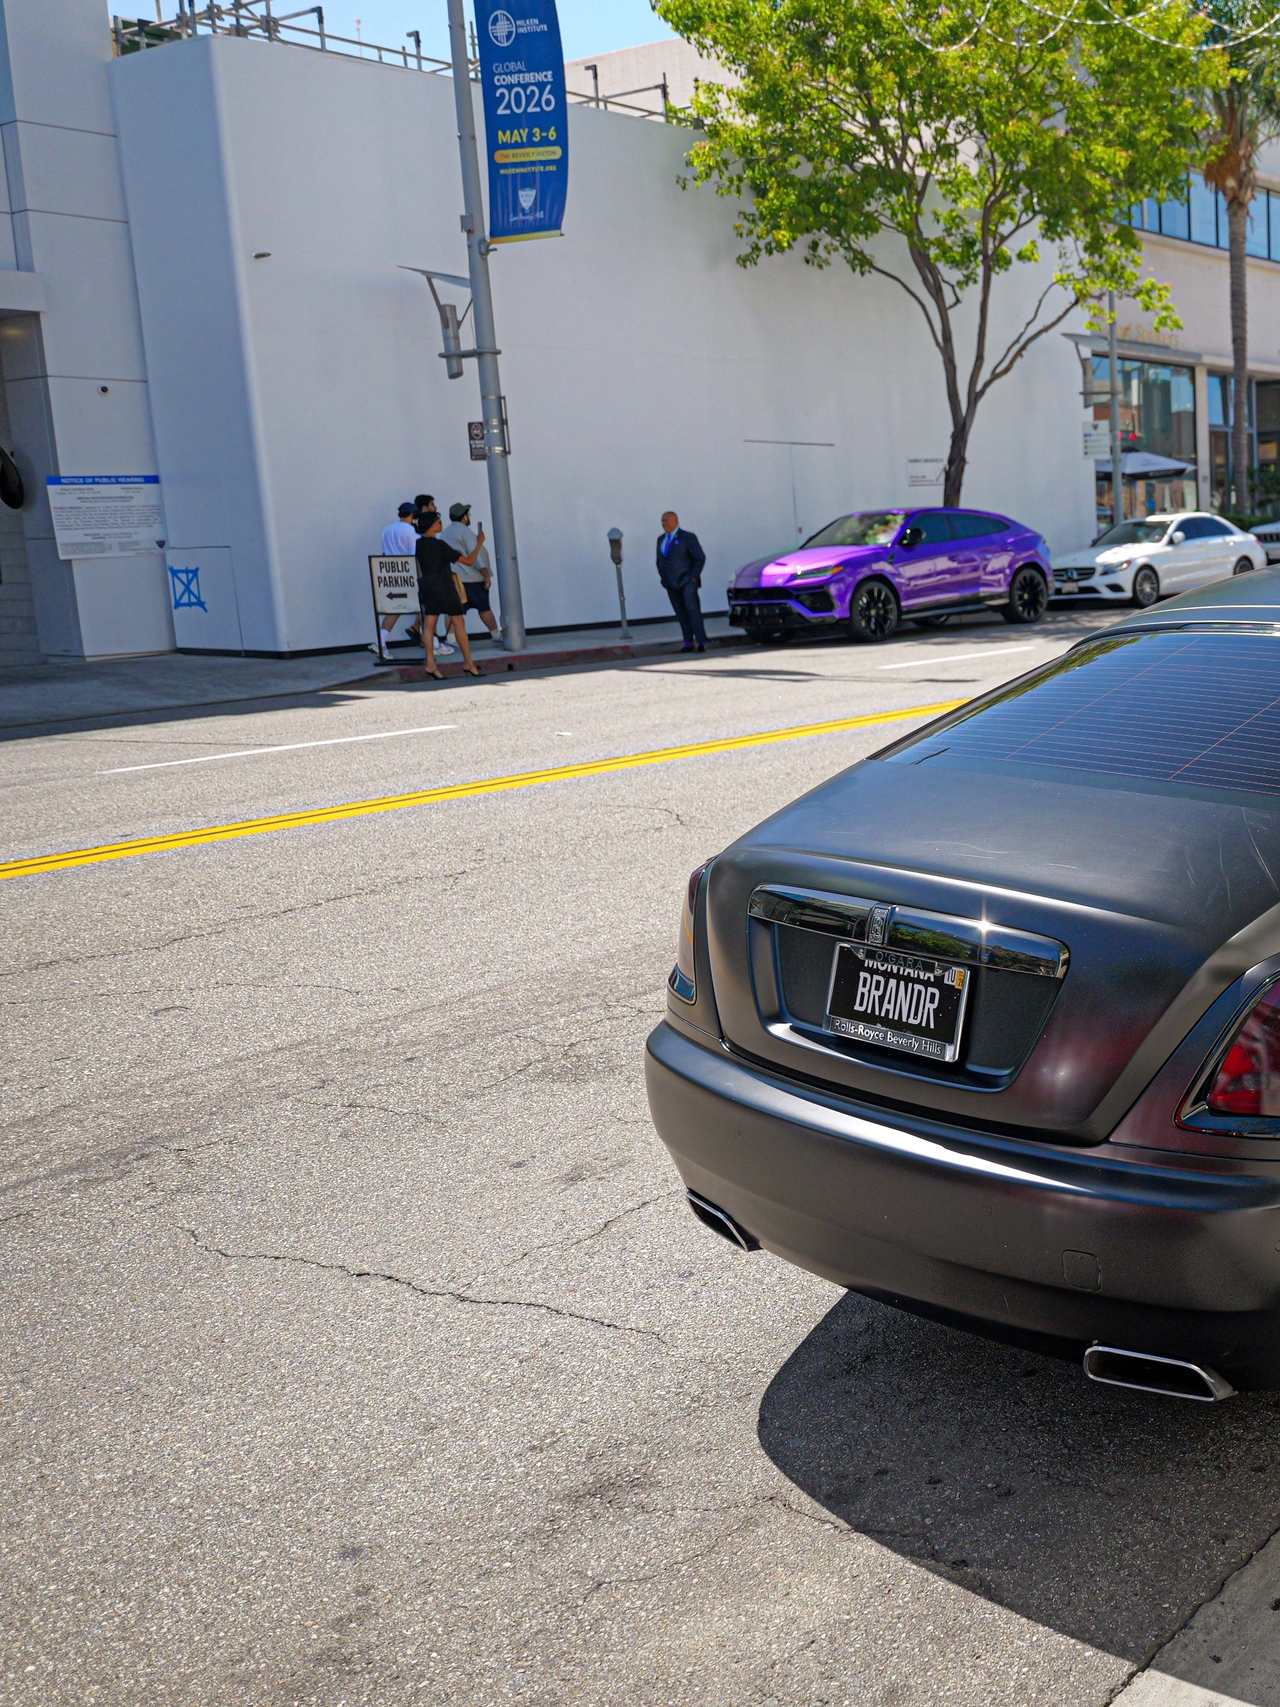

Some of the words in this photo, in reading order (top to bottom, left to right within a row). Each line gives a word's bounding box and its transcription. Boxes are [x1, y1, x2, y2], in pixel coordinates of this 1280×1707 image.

[516, 18, 539, 26] MILKEN
[517, 24, 548, 34] INSTITUTE
[493, 61, 527, 74] GLOBAL
[494, 71, 553, 86] CONFERENCE
[496, 84, 555, 115] 2026
[498, 128, 528, 144] MAY
[532, 126, 557, 142] 3-6
[512, 151, 535, 159] BEVERLY
[379, 561, 410, 573] PUBLIC
[377, 575, 415, 588] PARKING
[876, 951, 924, 971] O'GARA
[854, 971, 940, 1029] BRANDR
[834, 1020, 885, 1041] Rolls-Royce
[887, 1031, 920, 1052] Beverly
[921, 1040, 942, 1055] Hills
